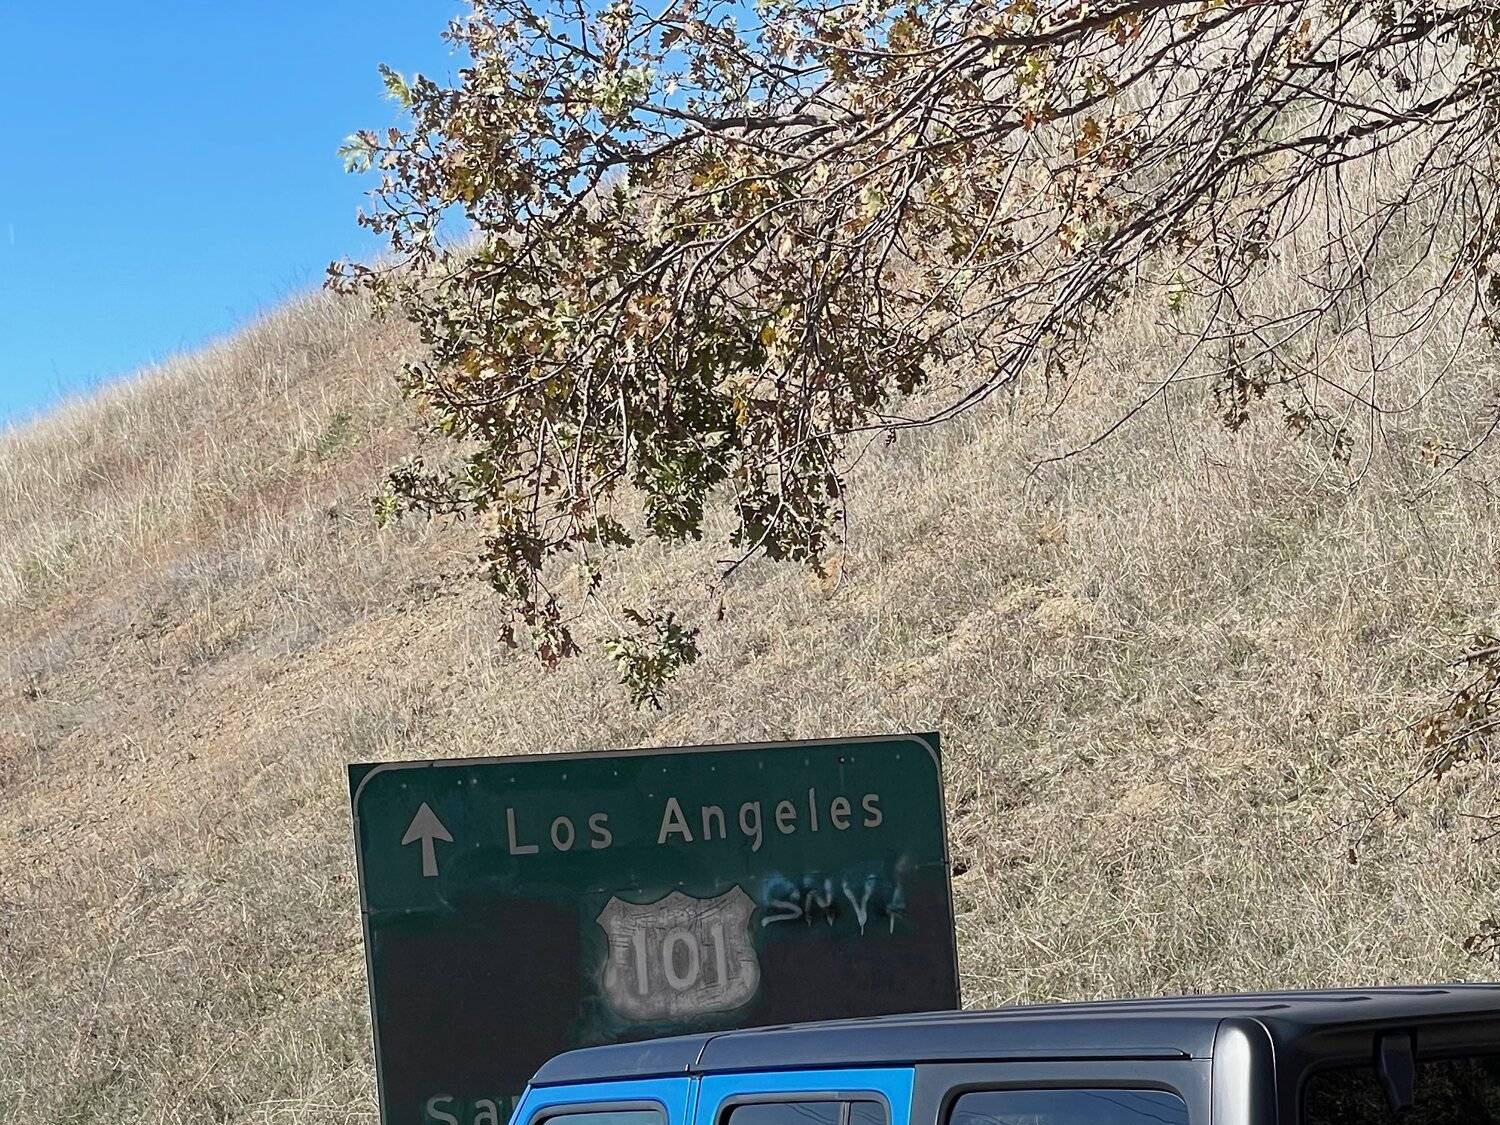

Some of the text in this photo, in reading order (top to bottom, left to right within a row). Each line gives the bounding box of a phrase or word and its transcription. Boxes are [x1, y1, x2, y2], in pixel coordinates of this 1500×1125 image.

[505, 788, 884, 856] Los Angeles
[632, 922, 728, 995] 101
